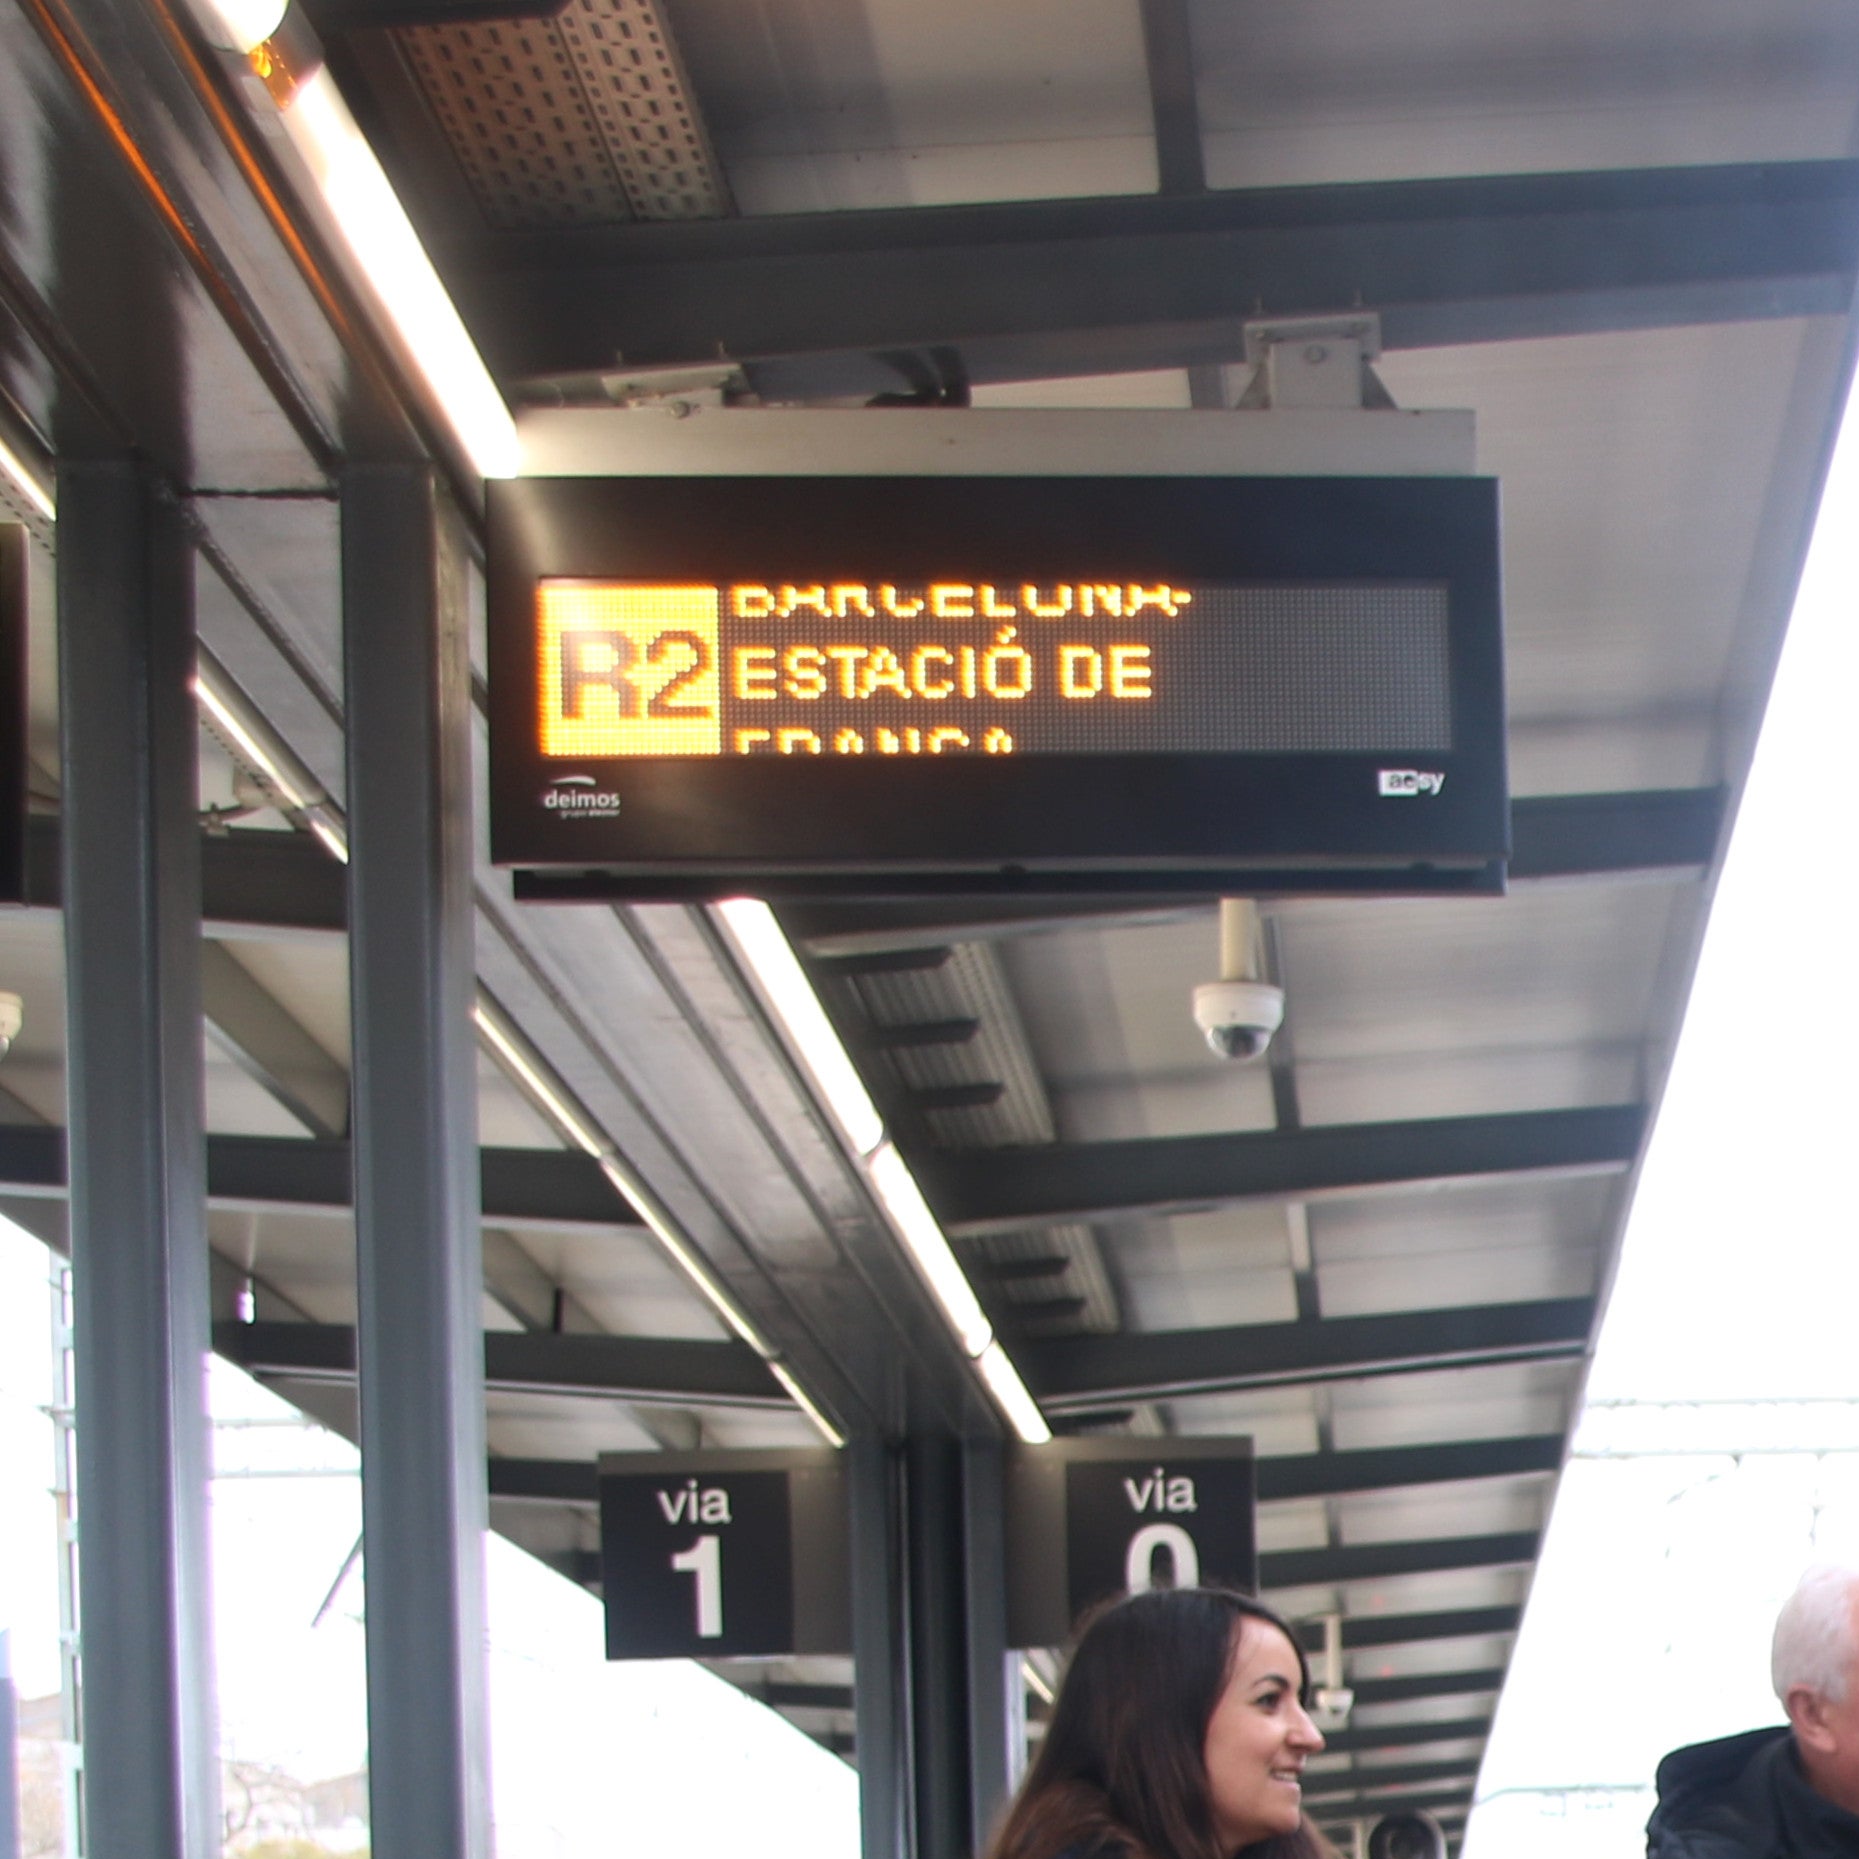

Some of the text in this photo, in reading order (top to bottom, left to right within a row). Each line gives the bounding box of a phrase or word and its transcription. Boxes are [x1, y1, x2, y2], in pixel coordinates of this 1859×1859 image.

[560, 630, 714, 719] R2
[733, 626, 1152, 699] ESTACIÓ DE
[544, 789, 620, 809] deimos
[657, 1478, 732, 1524] via
[1124, 1466, 1198, 1512] via
[670, 1535, 723, 1638] 1
